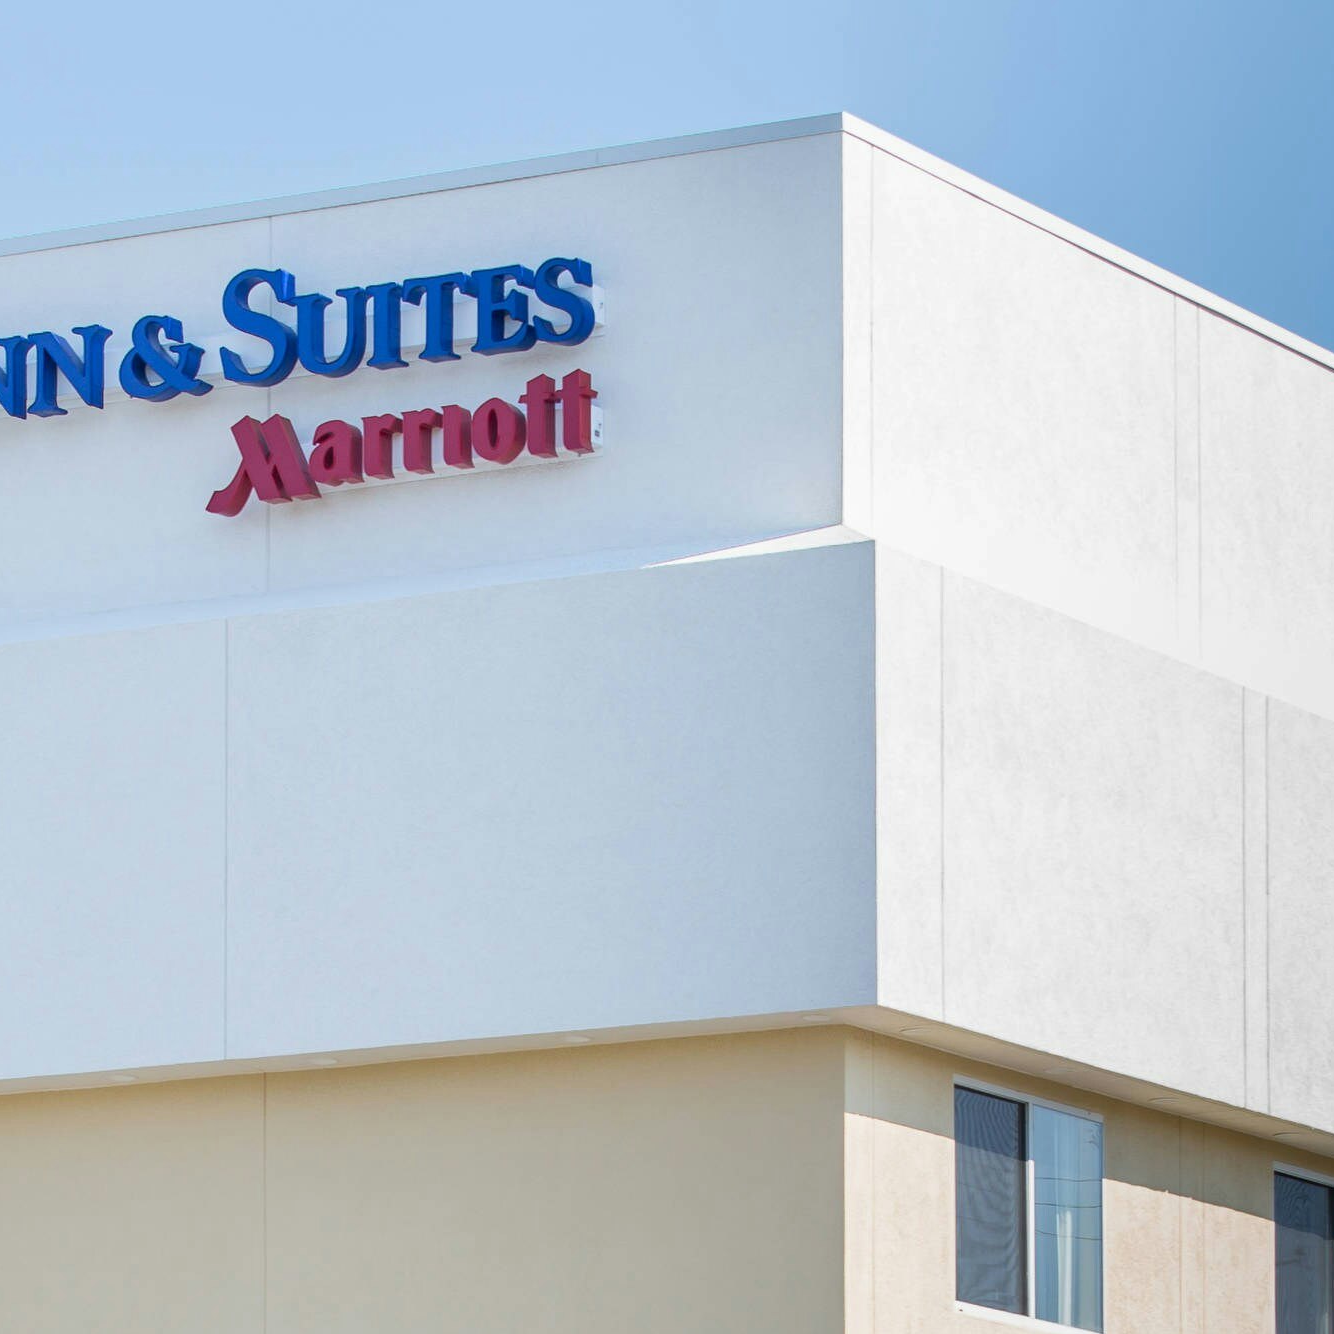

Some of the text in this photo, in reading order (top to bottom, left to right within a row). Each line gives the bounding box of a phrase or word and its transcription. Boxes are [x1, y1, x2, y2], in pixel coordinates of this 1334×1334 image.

[119, 315, 214, 402] &
[219, 257, 596, 387] SUITES
[205, 368, 599, 518] Marriott
